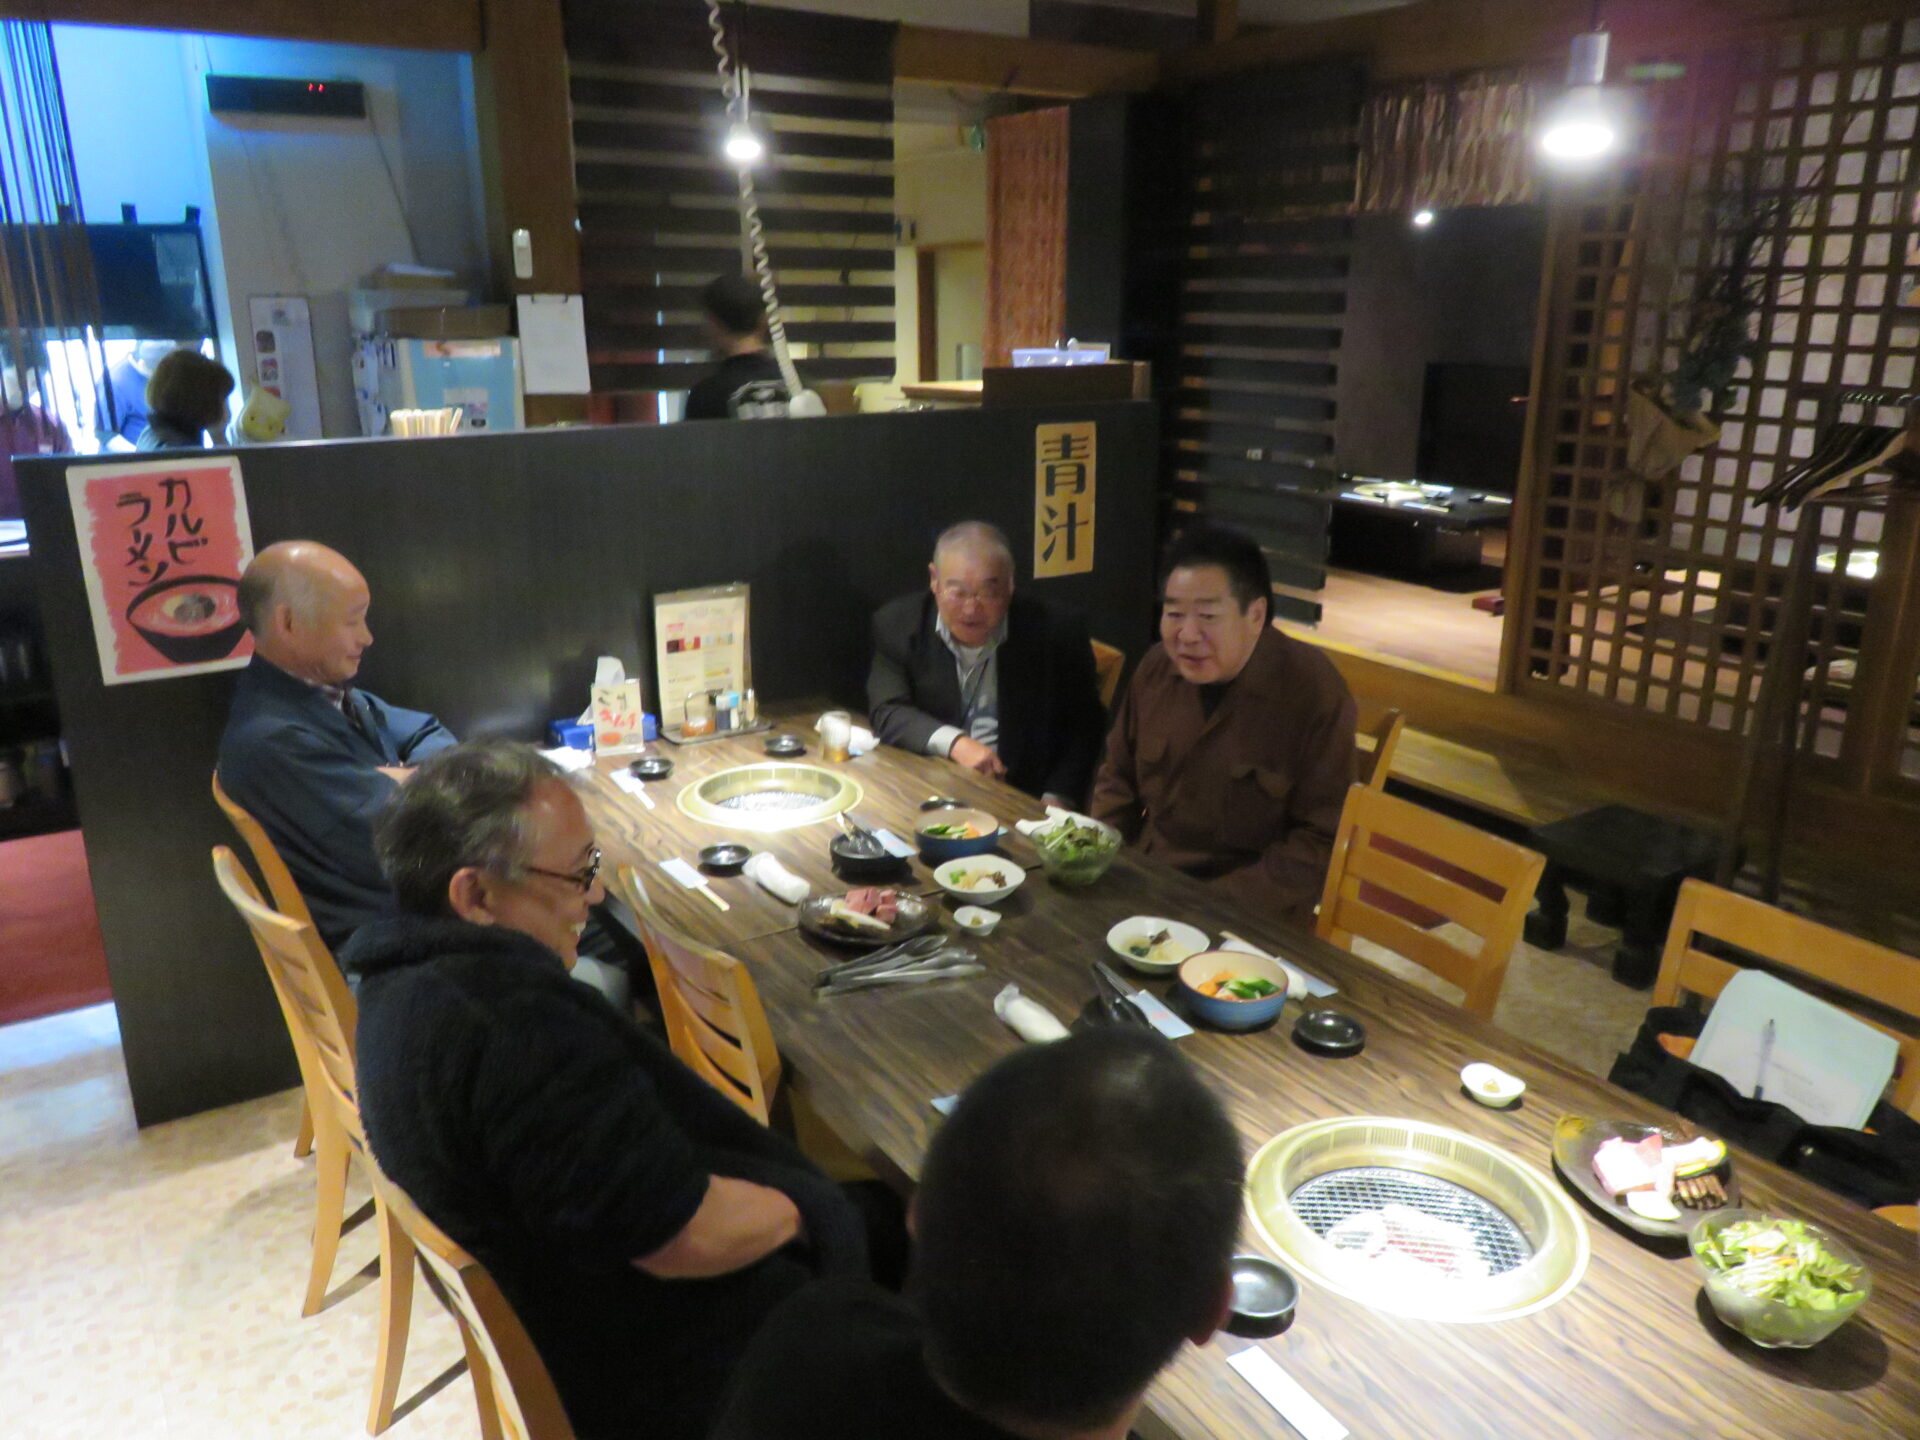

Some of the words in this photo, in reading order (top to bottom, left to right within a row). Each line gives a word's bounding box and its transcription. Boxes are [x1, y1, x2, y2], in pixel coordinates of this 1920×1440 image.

[158, 477, 208, 565] カルビ
[1041, 433, 1090, 562] 青汁
